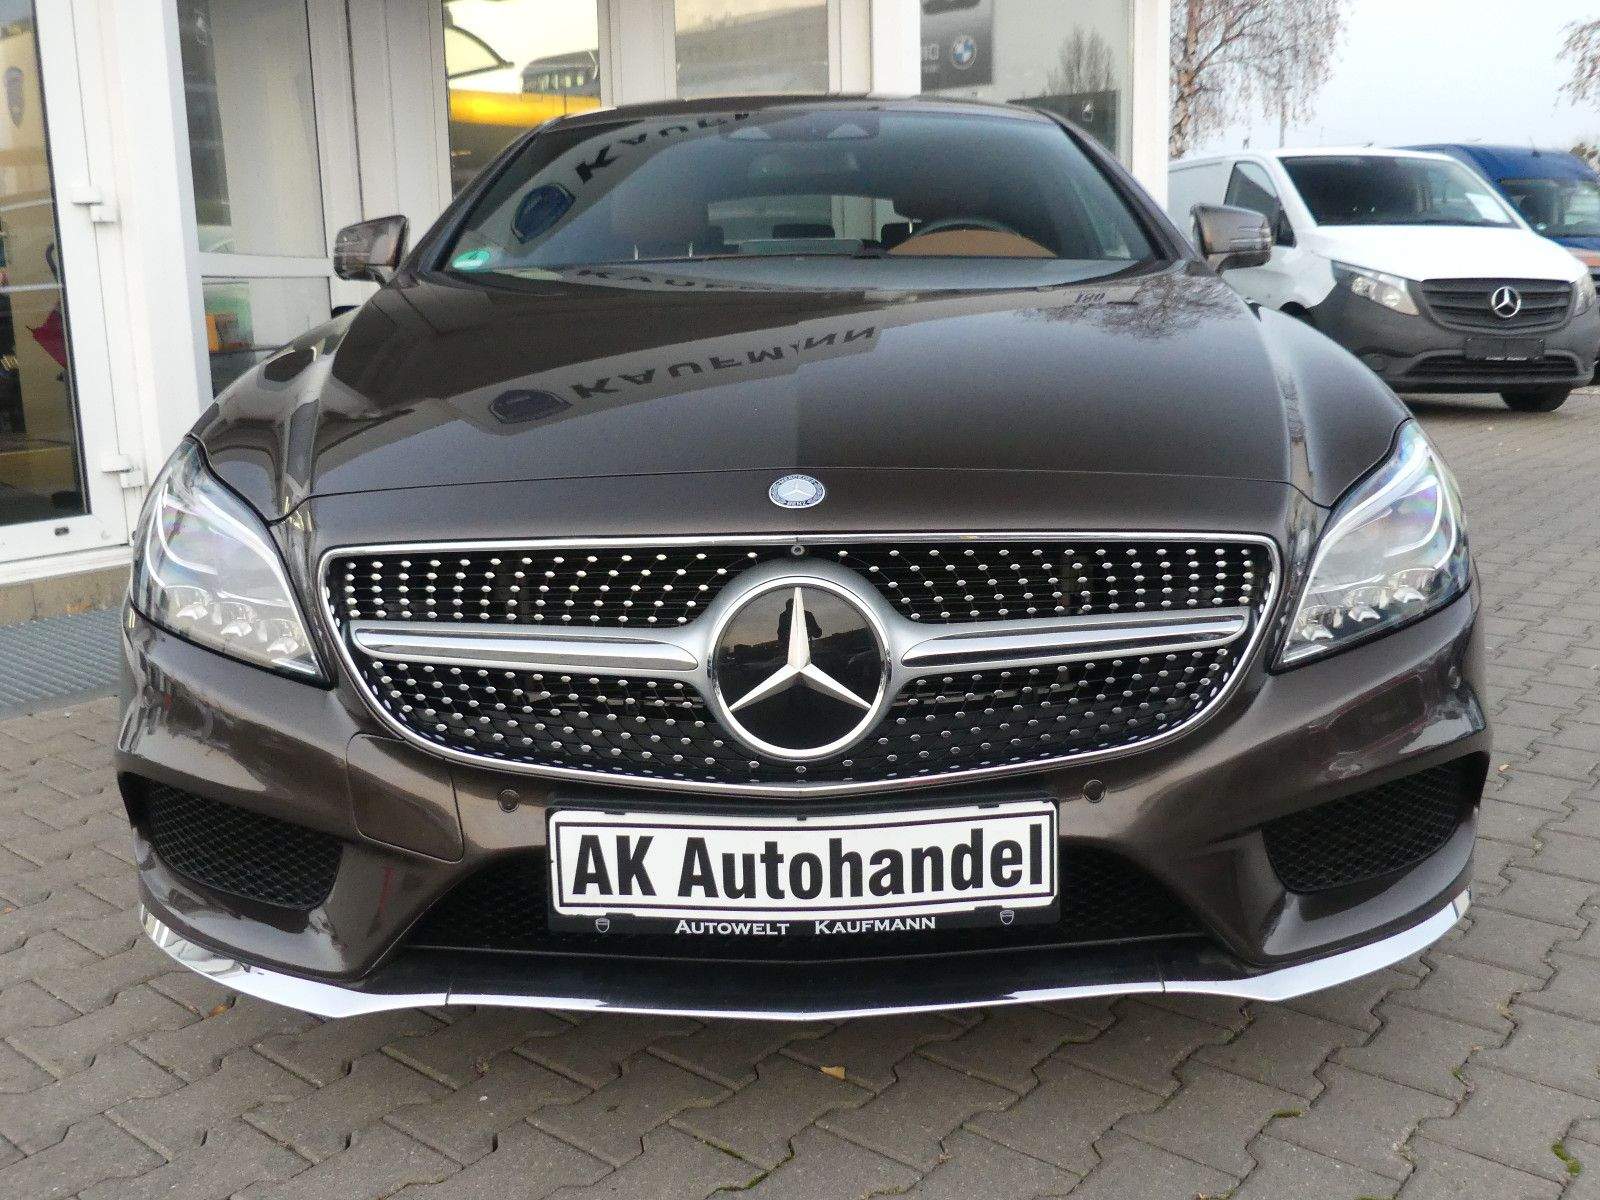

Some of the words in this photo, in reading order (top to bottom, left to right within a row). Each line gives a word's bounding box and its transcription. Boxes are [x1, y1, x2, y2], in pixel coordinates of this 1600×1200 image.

[572, 834, 658, 896] AK
[677, 824, 1043, 900] Autohandel
[674, 919, 790, 936] AUTOWELT
[814, 916, 937, 935] KAUFMANN
